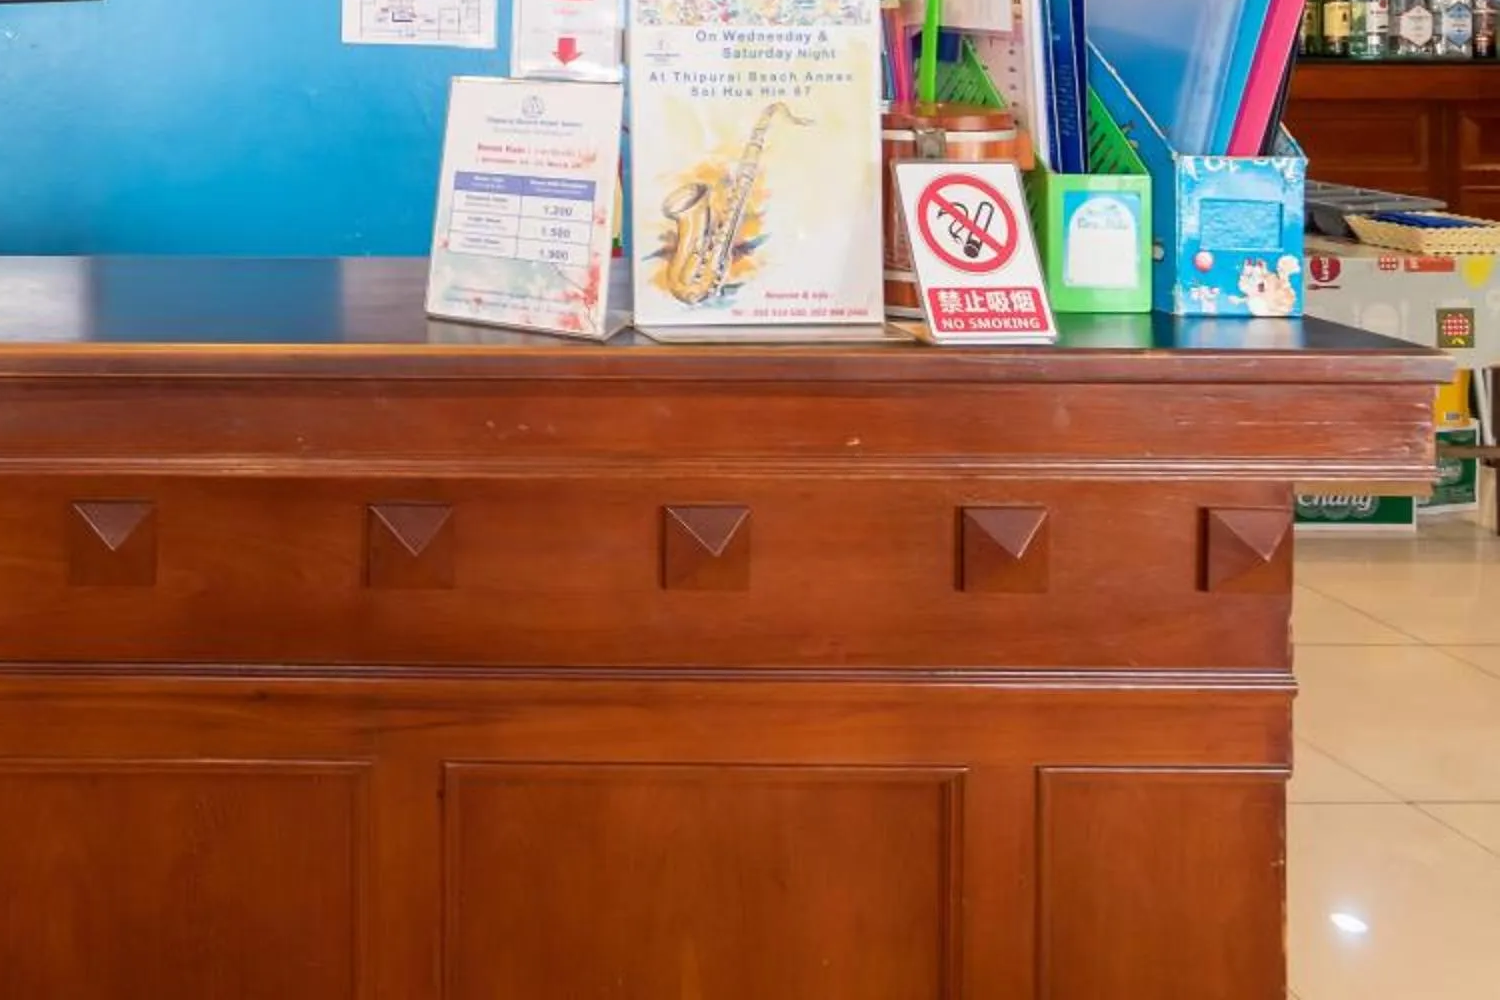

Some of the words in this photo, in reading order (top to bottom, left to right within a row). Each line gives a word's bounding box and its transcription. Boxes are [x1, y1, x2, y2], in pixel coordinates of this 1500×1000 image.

[695, 30, 717, 42] On
[723, 29, 812, 44] Wednesday
[817, 30, 829, 42] &
[723, 47, 793, 61] Saturday
[797, 48, 836, 61] Night
[649, 72, 666, 82] At
[749, 71, 797, 82] Beach
[937, 290, 1037, 313] 禁止吸烟
[942, 318, 965, 329] NO
[969, 317, 1041, 329] SMOKING
